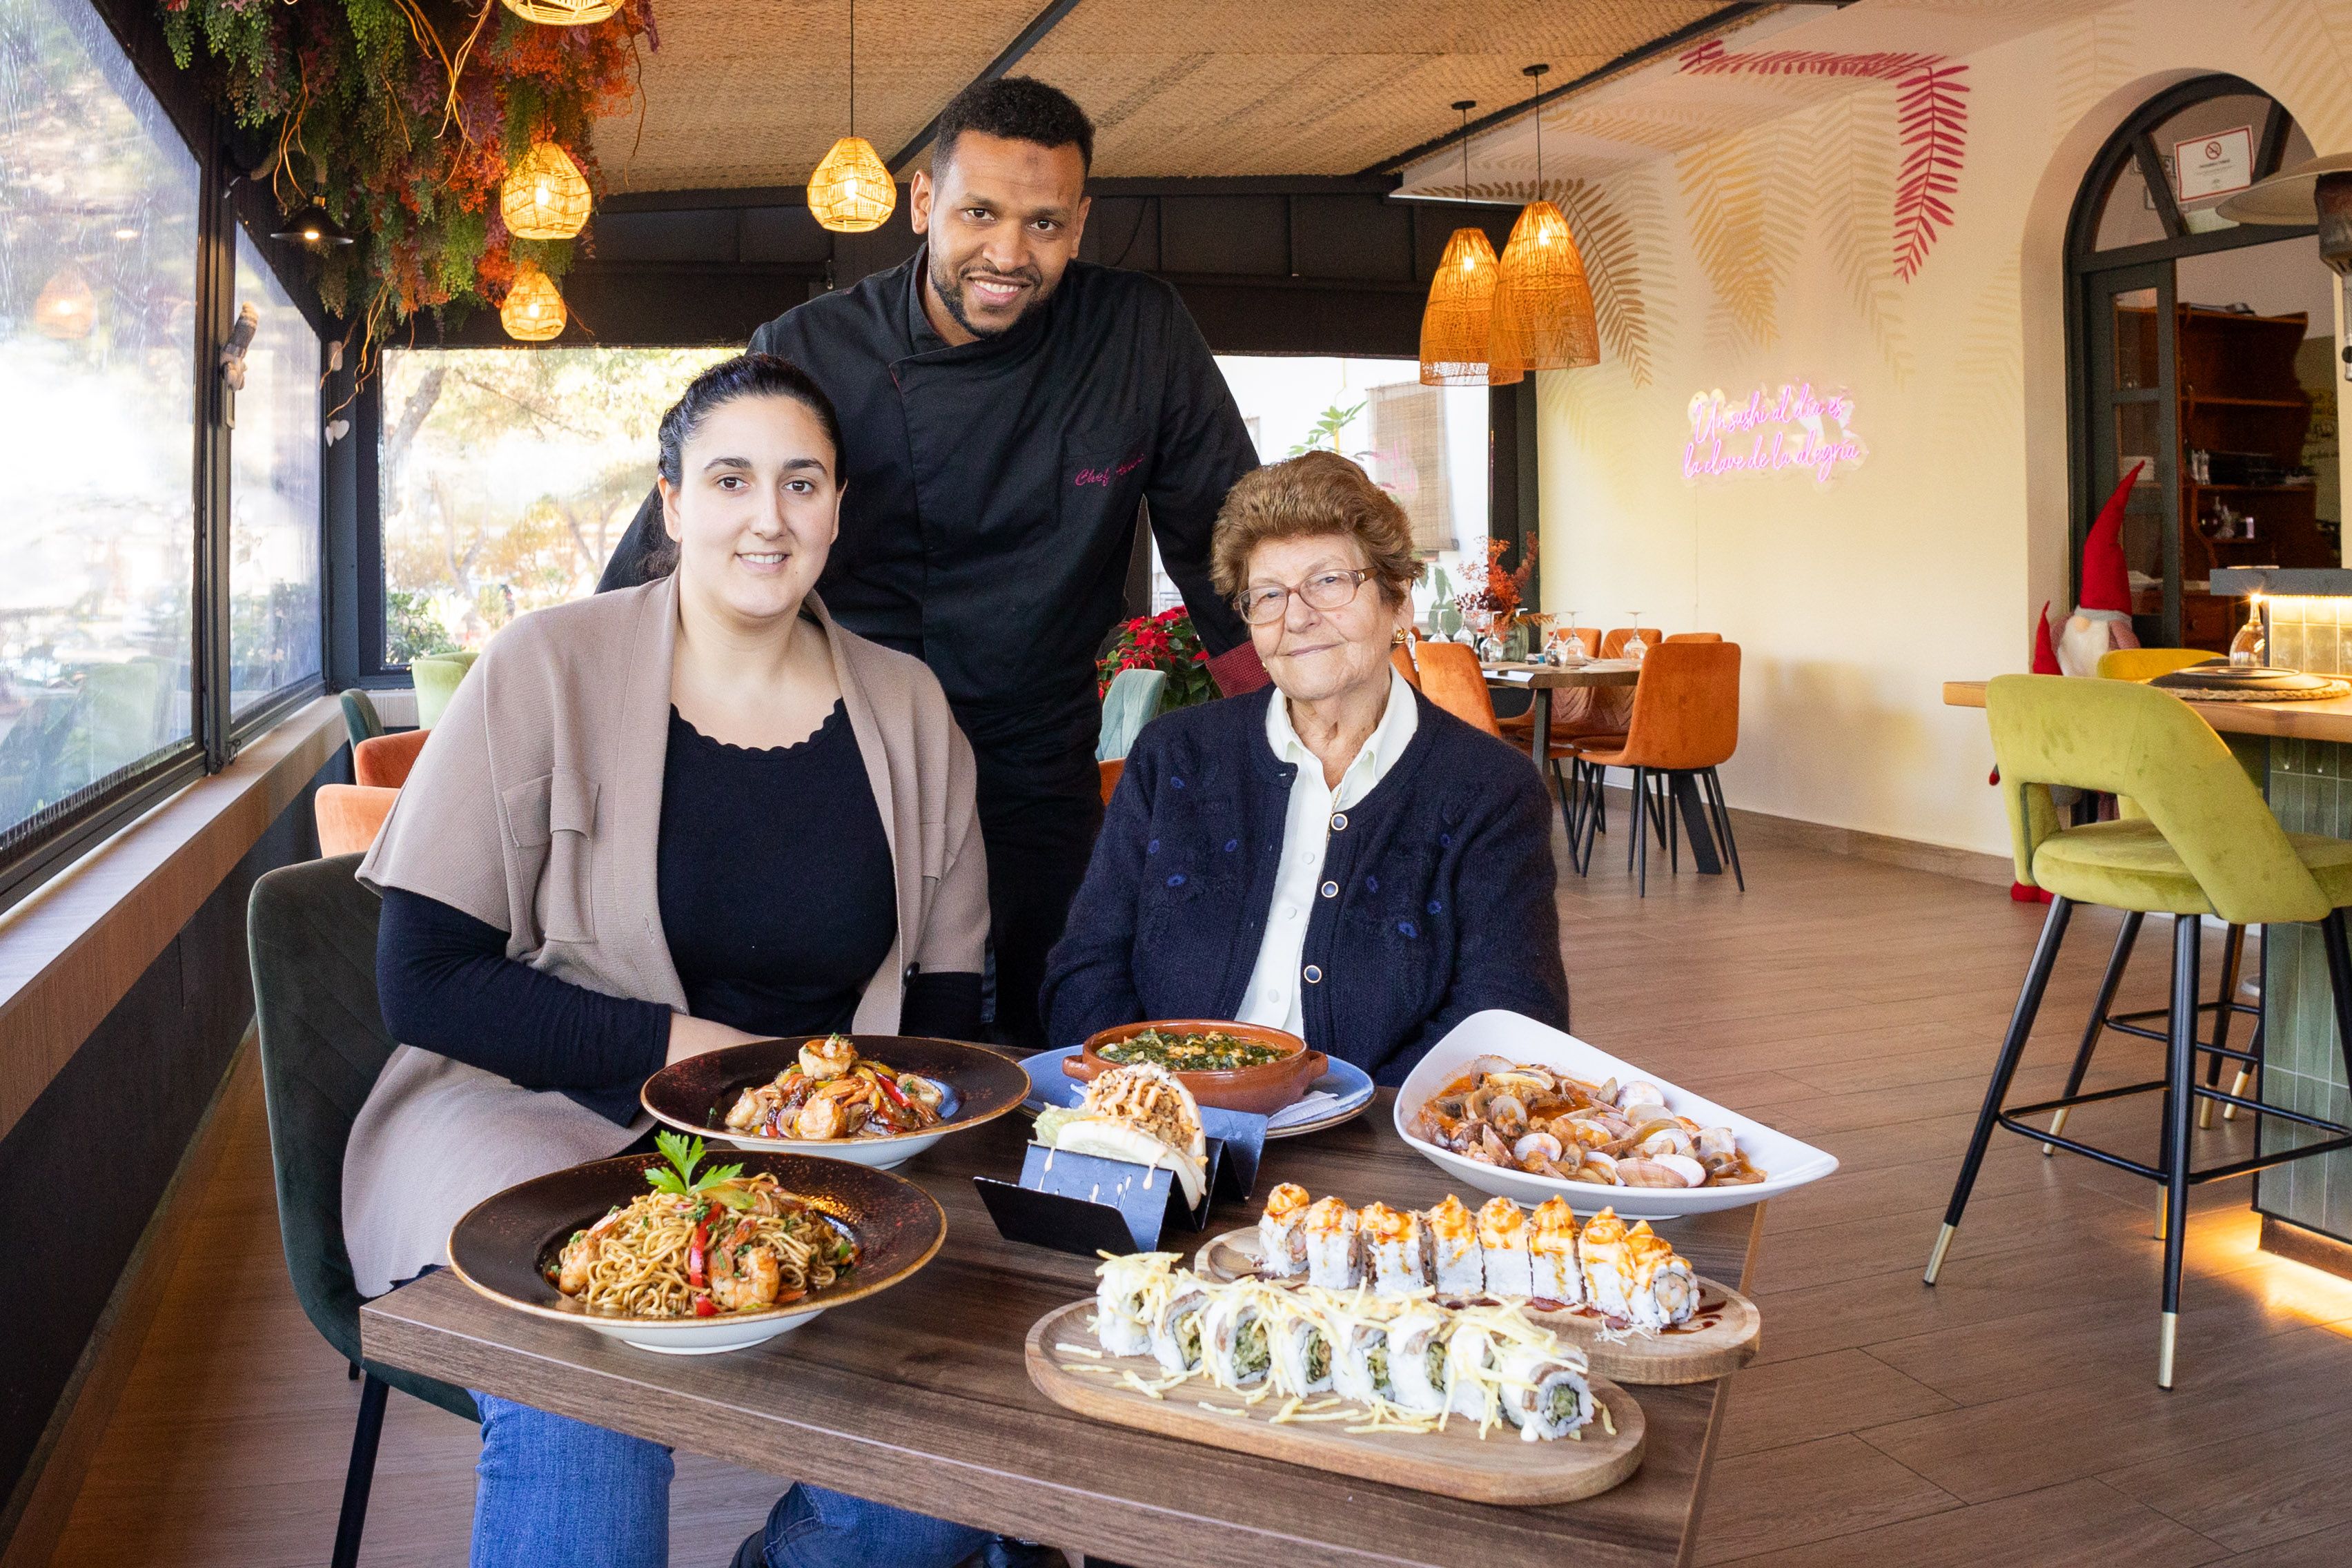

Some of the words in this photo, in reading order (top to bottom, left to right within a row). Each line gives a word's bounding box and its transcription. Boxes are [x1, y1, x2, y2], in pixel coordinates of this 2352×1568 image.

[1694, 401, 1727, 444] Un
[1727, 391, 1768, 432] sushi
[1772, 385, 1791, 423] al
[1828, 396, 1843, 419] es
[1075, 467, 1110, 487] Chef
[1684, 442, 1702, 478] la
[1703, 438, 1746, 475] clave
[1747, 435, 1769, 469] de
[1772, 431, 1792, 469] la
[1796, 428, 1860, 482] alegría
